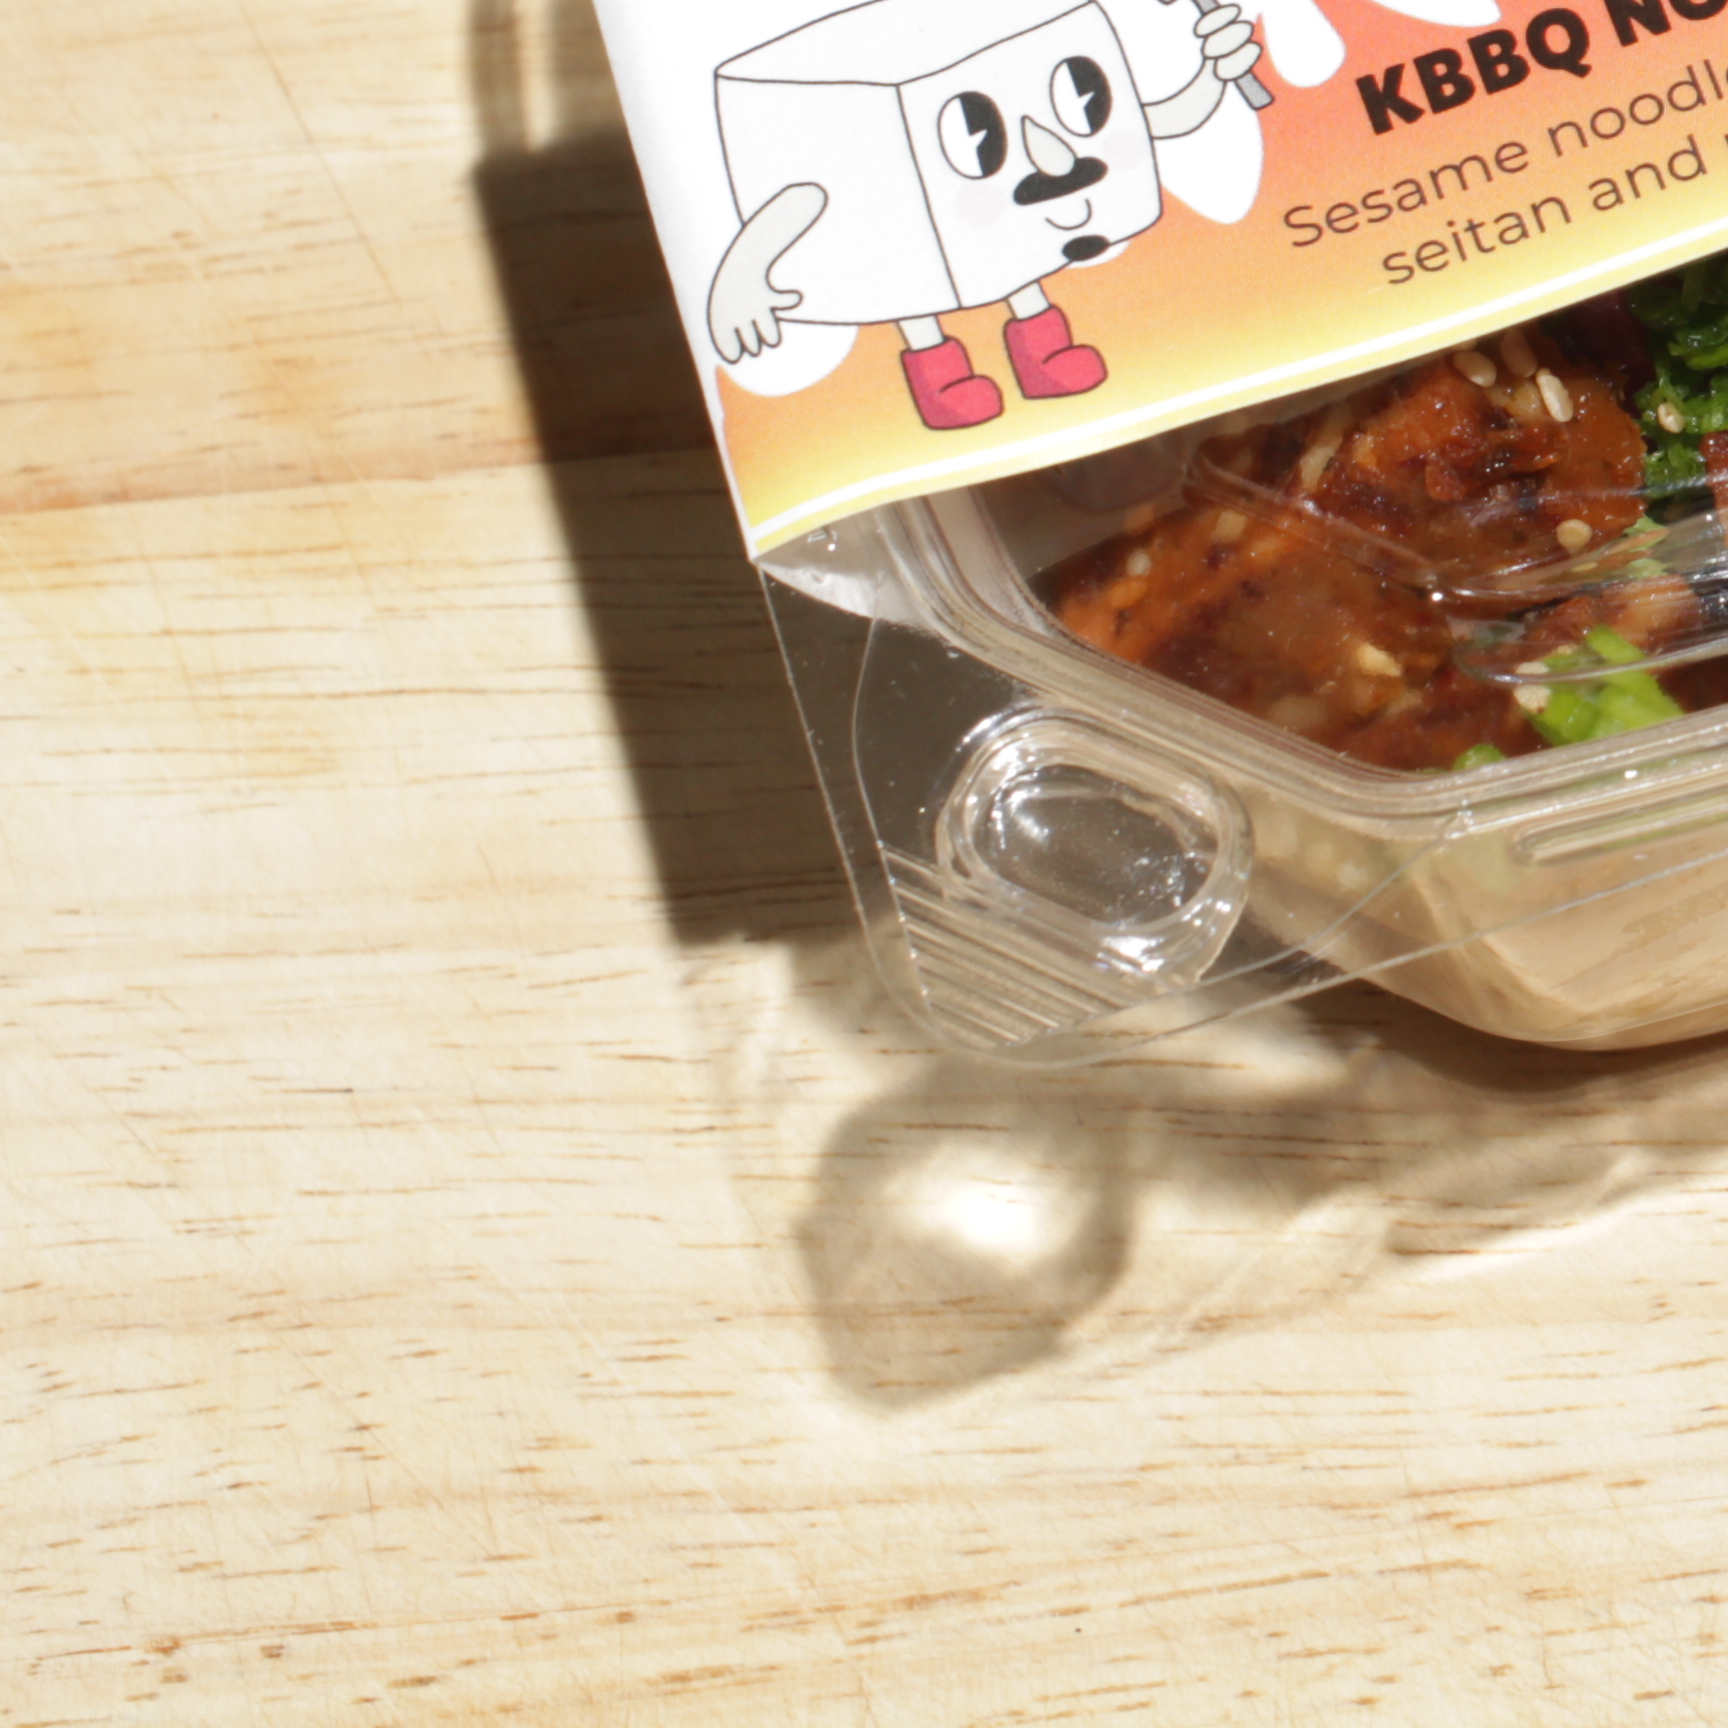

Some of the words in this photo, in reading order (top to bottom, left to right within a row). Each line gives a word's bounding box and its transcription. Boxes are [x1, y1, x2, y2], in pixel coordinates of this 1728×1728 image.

[1355, 7, 1591, 135] KBBQ
[1282, 141, 1529, 248] Sesame
[1381, 196, 1572, 285] seitan
[1587, 133, 1708, 212] and
